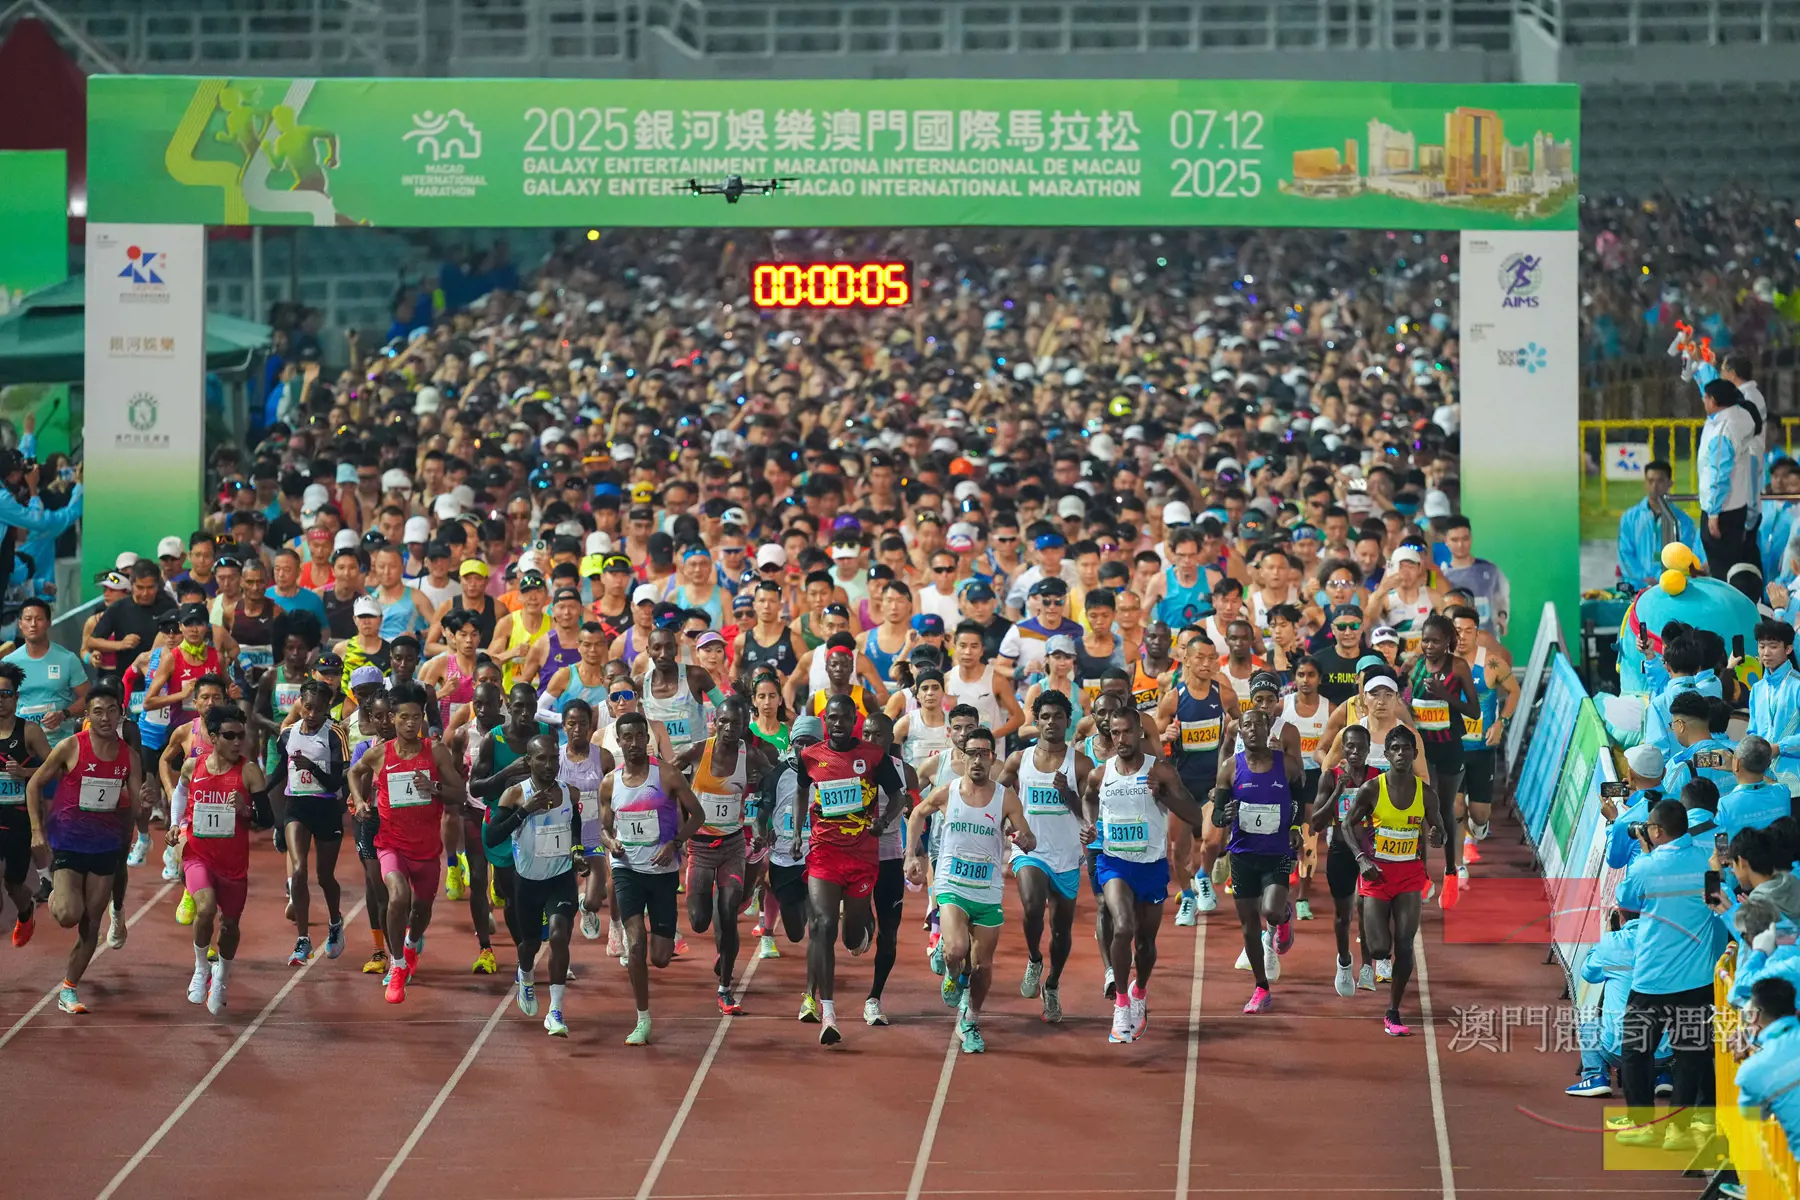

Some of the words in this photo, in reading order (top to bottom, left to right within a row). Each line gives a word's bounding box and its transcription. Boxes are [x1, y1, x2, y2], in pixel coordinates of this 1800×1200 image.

[523, 107, 1141, 152] 2025銀河娛樂澳門國際馬拉松
[1170, 109, 1264, 150] 07.12
[523, 157, 599, 175] GALAXY
[604, 157, 768, 175] ENTERTAINMENT
[774, 157, 879, 175] MARATONA
[884, 158, 1039, 175] INTERNACIONAL
[1042, 158, 1068, 175] DE
[1072, 158, 1141, 175] MACAU
[401, 174, 488, 186] INTERNATIONAL
[1170, 158, 1262, 198] 2025
[414, 186, 475, 197] MARATHON
[523, 178, 602, 196] GALAXY
[784, 178, 855, 196] MACAO
[861, 179, 1023, 196] INTERNATIONAL
[1028, 179, 1141, 196] MARATHON
[754, 264, 909, 306] 00:00:05
[1501, 296, 1540, 309] AIMS
[1187, 728, 1217, 743] A3234
[300, 771, 313, 784] 63
[98, 788, 105, 802] 2
[406, 782, 413, 795] 4
[1105, 788, 1124, 797] CAPE
[1125, 786, 1148, 796] VERDE
[824, 788, 857, 806] B3177
[715, 804, 728, 817] 13
[207, 814, 219, 828] 11
[1255, 814, 1262, 827] 6
[630, 821, 644, 836] 14
[950, 821, 995, 837] PORTUGAL
[554, 835, 560, 849] 1
[1381, 840, 1414, 854] A2107
[954, 861, 988, 879] B3180
